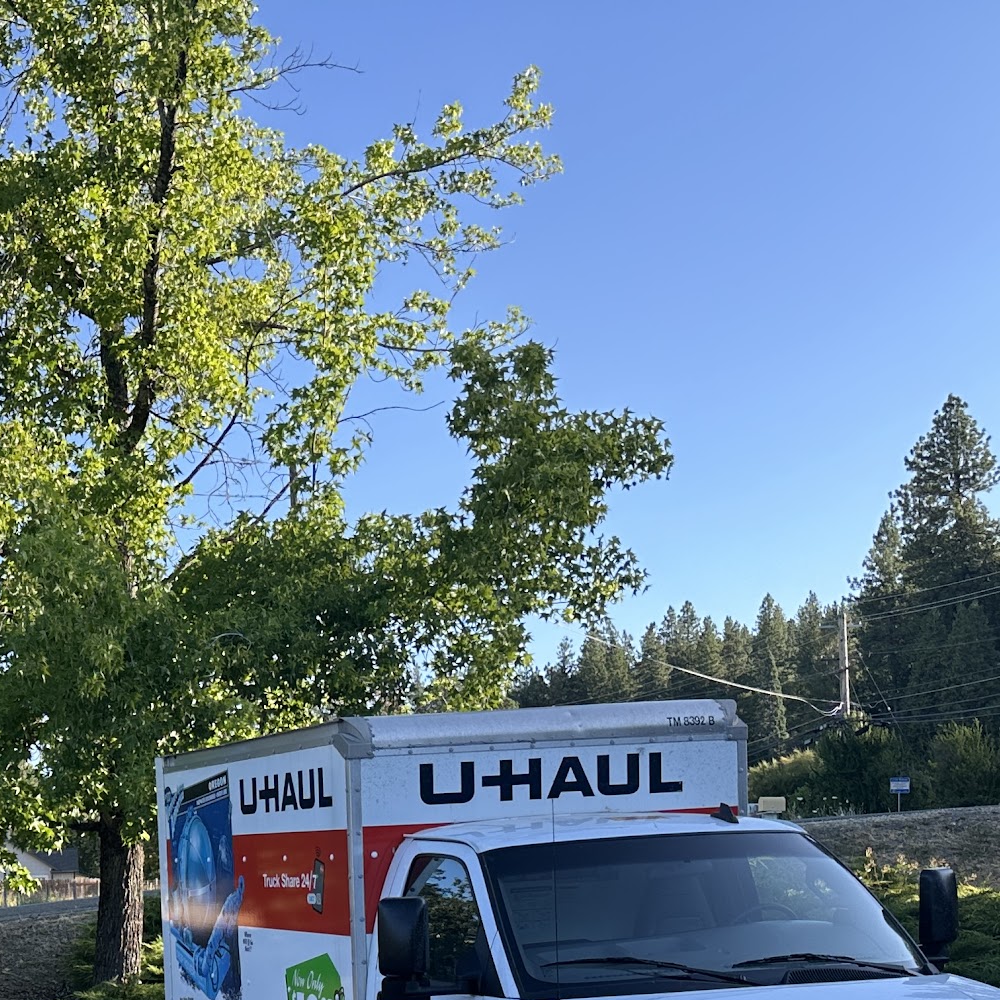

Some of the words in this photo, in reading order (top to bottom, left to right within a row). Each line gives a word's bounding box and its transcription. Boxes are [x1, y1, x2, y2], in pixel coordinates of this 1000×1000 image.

[666, 716, 682, 727] TM
[683, 715, 706, 727] 8392
[708, 715, 716, 726] B
[239, 767, 333, 815] U-HAUL
[419, 752, 683, 805] U-HAUL
[262, 873, 281, 888] Truck
[281, 872, 301, 888] Share
[301, 869, 319, 891] 24/7
[291, 968, 306, 988] Now
[306, 970, 325, 999] Only
